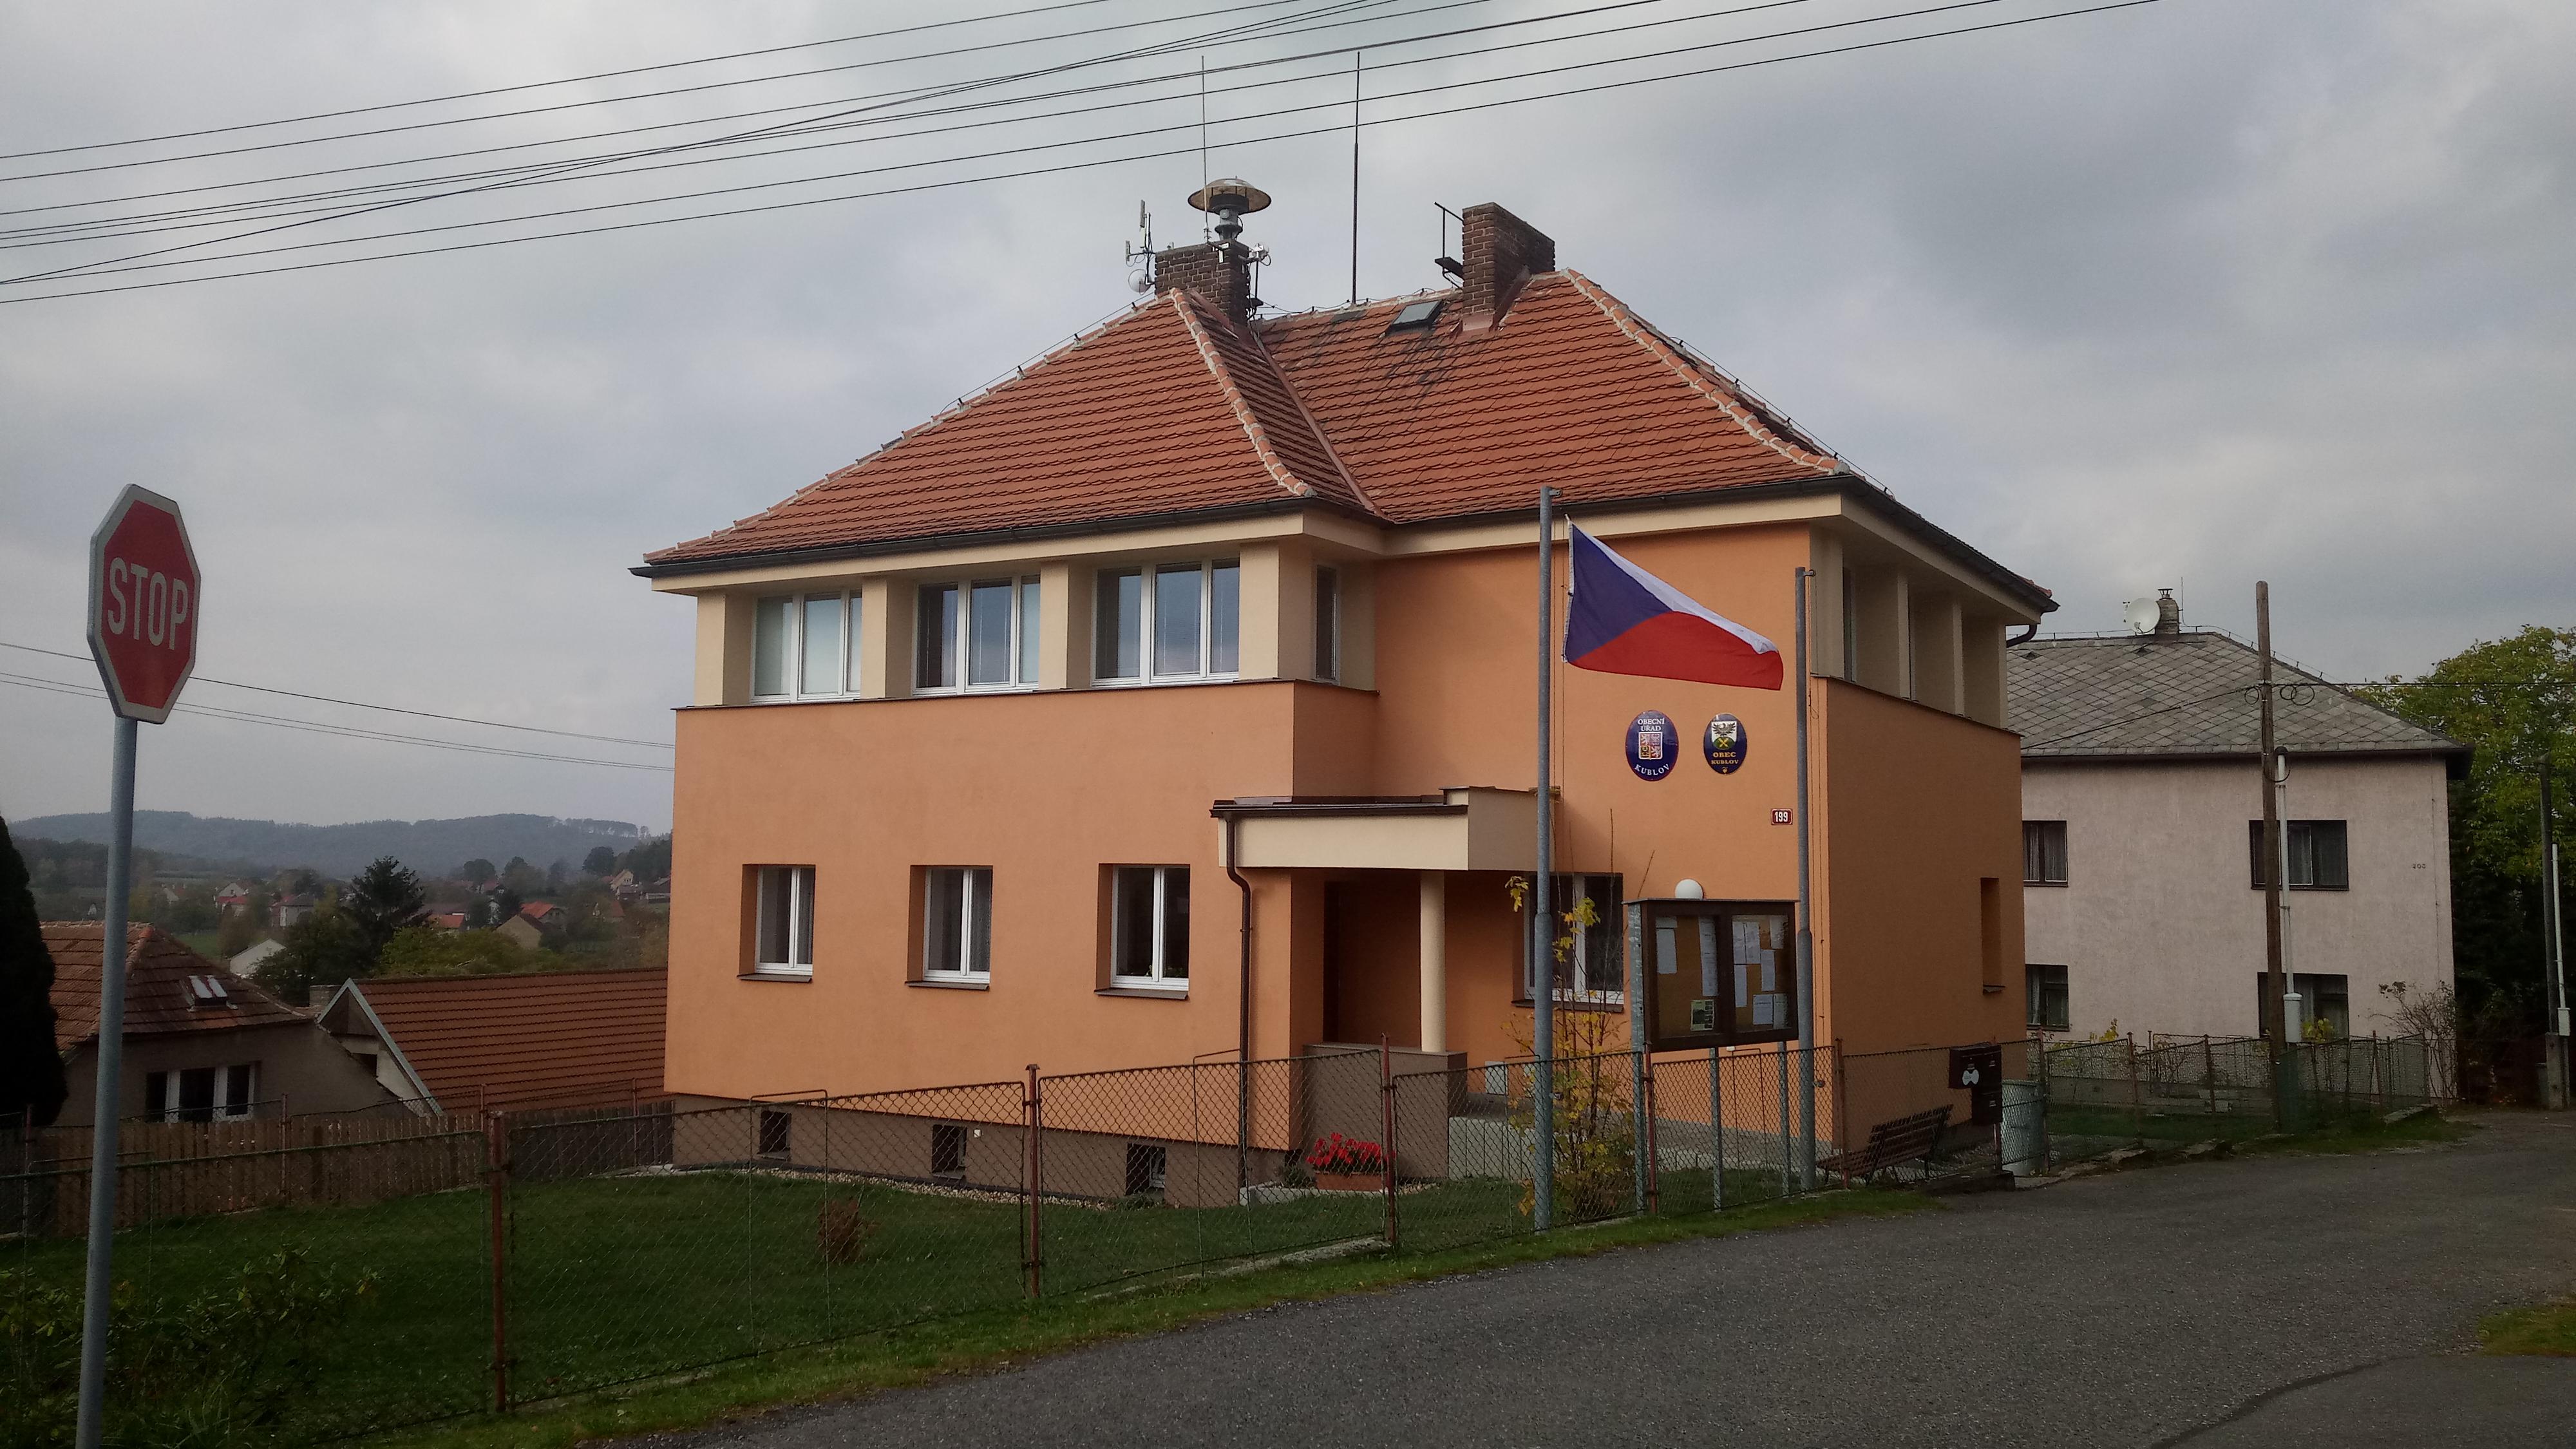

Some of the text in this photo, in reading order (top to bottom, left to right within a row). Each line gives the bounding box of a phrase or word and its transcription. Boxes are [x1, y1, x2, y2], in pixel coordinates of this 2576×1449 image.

[108, 557, 188, 650] STOP
[1634, 763, 1670, 776] KUBLOV
[1774, 811, 1788, 822] 199
